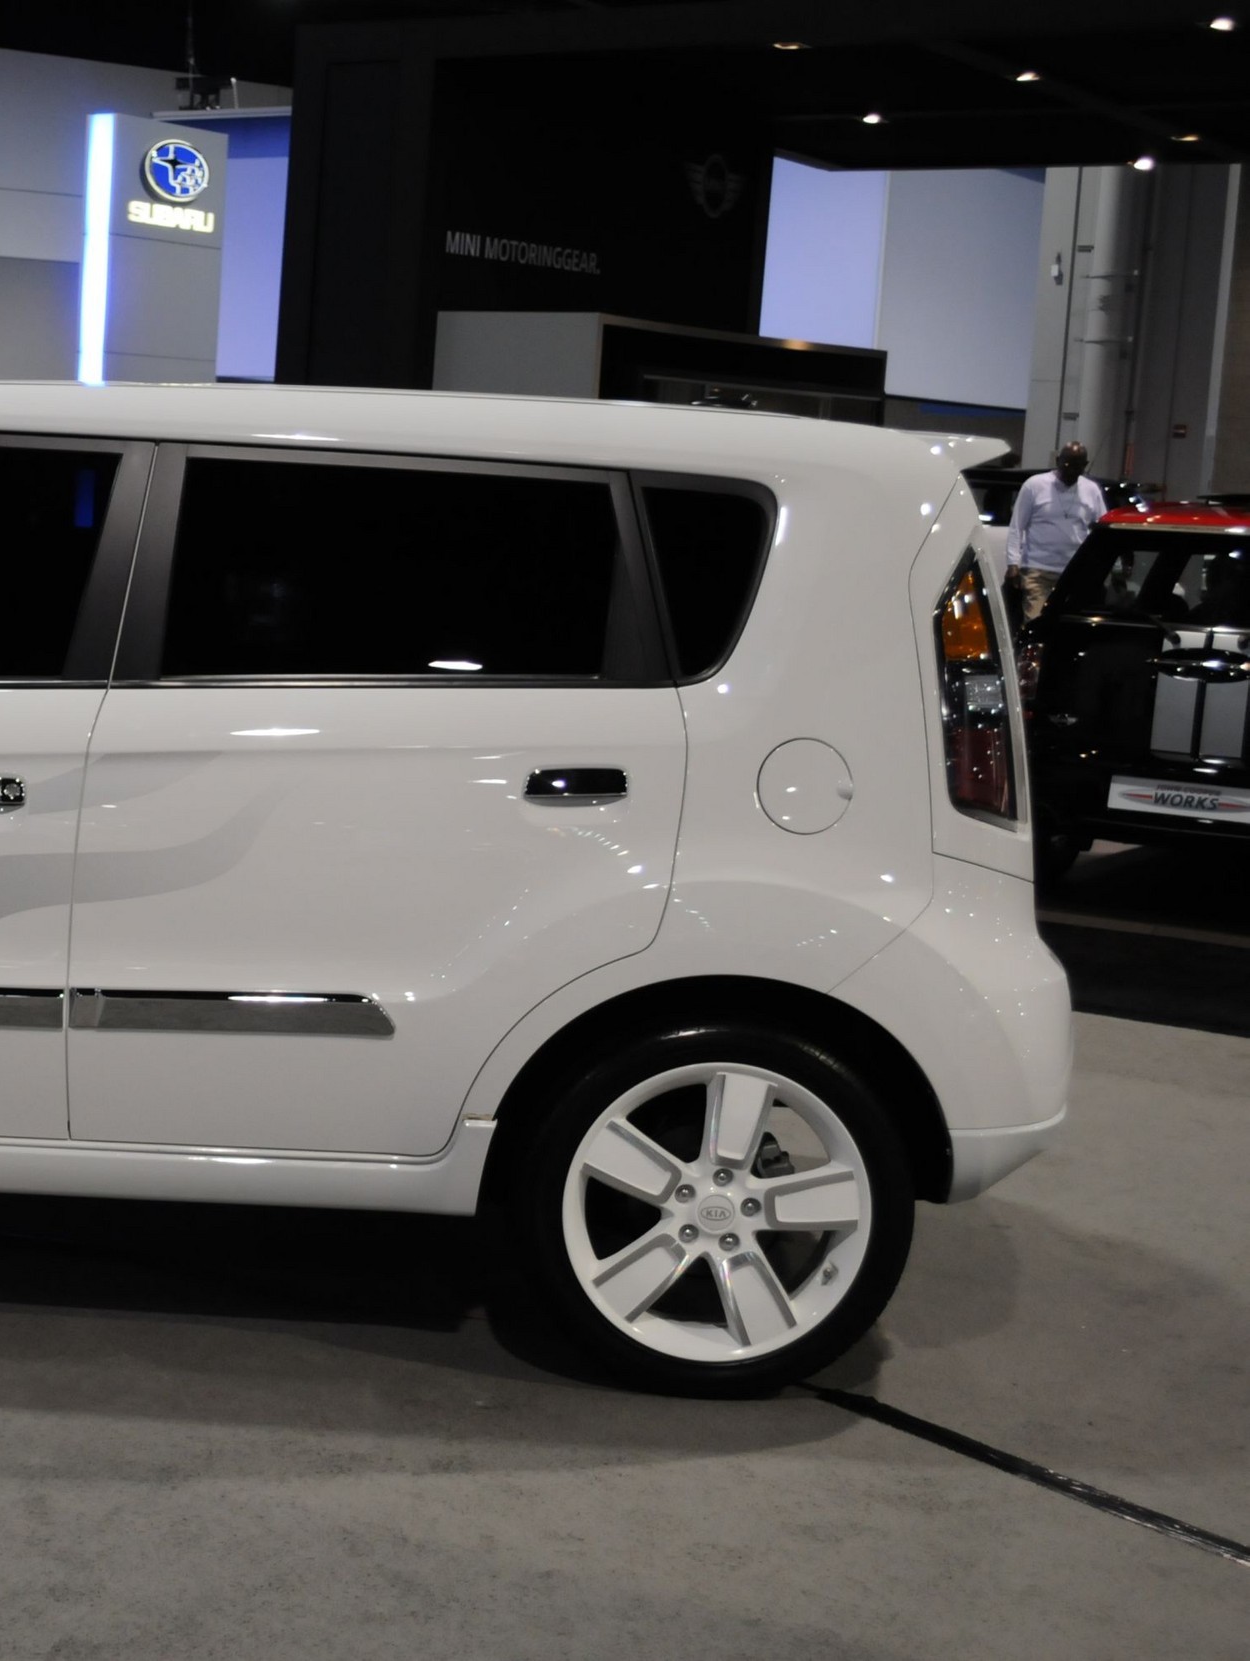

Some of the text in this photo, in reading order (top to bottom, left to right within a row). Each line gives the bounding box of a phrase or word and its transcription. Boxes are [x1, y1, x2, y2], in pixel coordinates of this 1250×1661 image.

[128, 200, 215, 233] SUBARU
[445, 230, 601, 275] MINI MOTORINGGEAR.
[1154, 792, 1219, 810] WORKS
[706, 1209, 727, 1218] KIA
